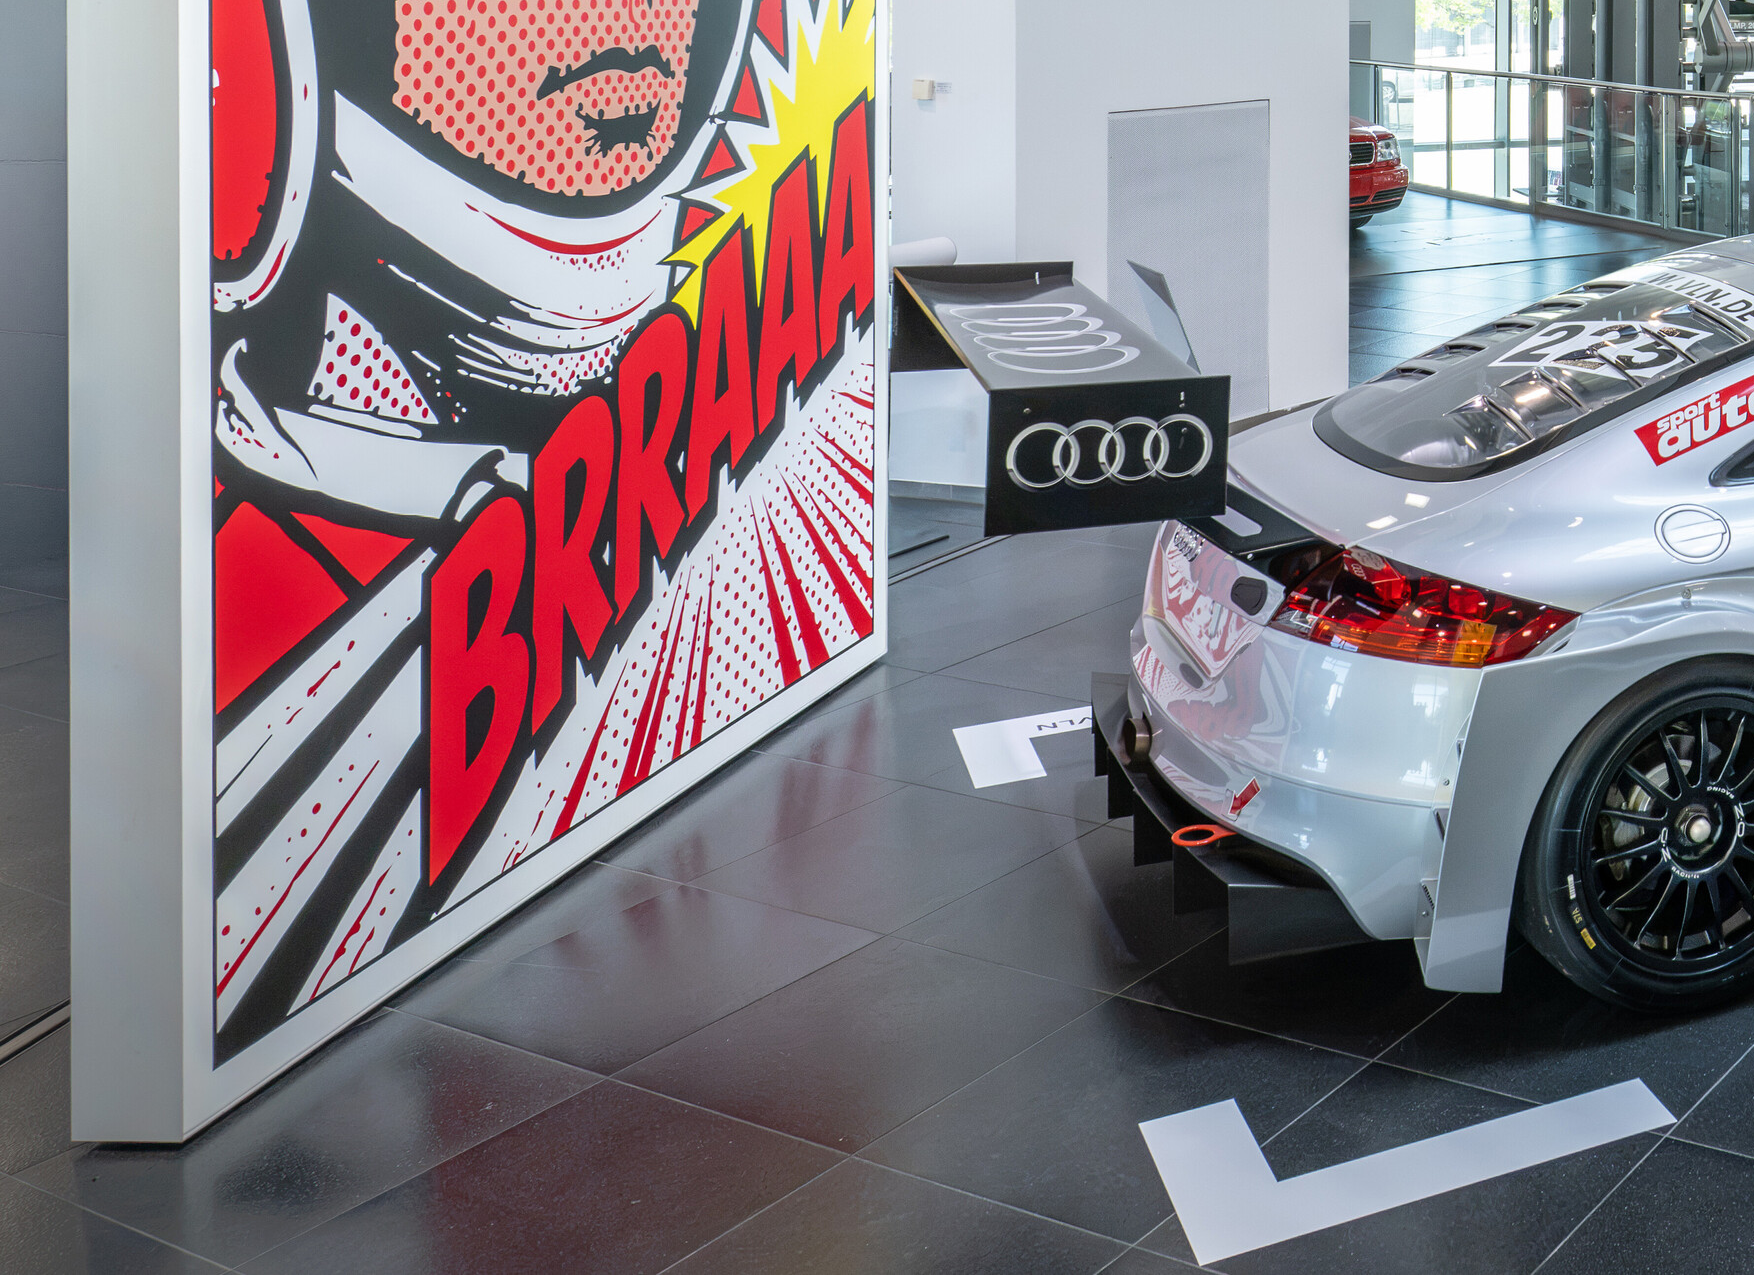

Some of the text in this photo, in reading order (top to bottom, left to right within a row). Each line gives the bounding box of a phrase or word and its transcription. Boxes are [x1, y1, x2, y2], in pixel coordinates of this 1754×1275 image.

[1656, 392, 1721, 435] sport
[428, 98, 875, 888] BRRAAA
[1706, 784, 1735, 801] RACING
